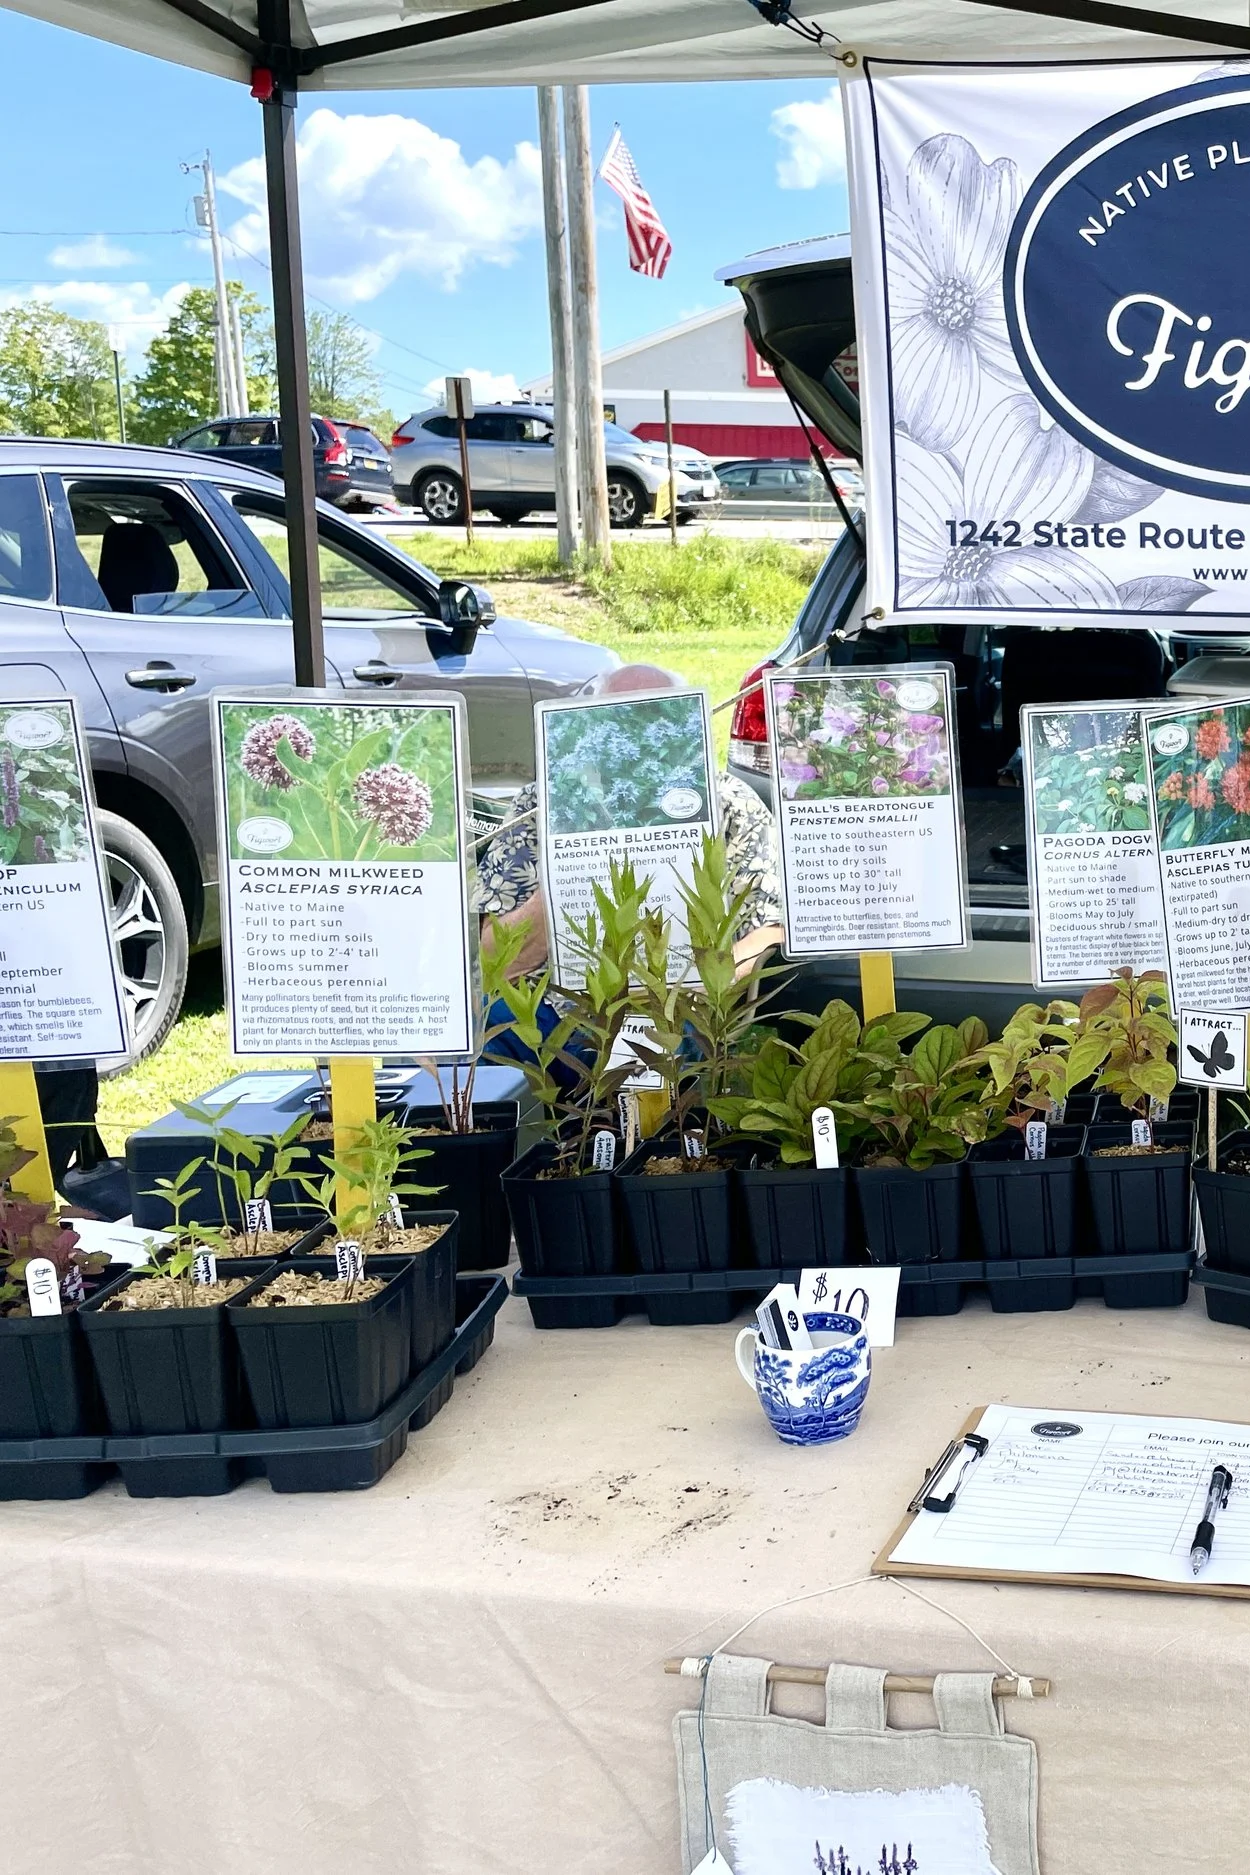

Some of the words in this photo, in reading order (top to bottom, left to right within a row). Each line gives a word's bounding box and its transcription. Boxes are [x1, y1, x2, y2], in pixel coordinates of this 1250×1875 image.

[1078, 154, 1195, 247] NATIVE
[945, 520, 1022, 547] 1242
[1033, 520, 1127, 549] State
[1140, 522, 1245, 550] Route
[788, 804, 840, 814] SMALL'S
[845, 802, 934, 812] BEARDTONGUE
[790, 816, 864, 826] PENSTEMON
[868, 814, 918, 823] SMALLII
[554, 836, 618, 849] EASTERN
[624, 828, 699, 844] BLUESTAR
[830, 832, 842, 840] to
[845, 830, 915, 840] southeastern
[918, 827, 933, 836] US
[1043, 837, 1106, 848] PAGODA
[554, 850, 600, 860] AMSONIA
[1044, 850, 1100, 860] CORNUS
[1165, 848, 1235, 865] BUTTERFLY
[828, 859, 839, 867] to
[842, 857, 859, 868] dry
[862, 856, 887, 865] soils
[239, 865, 320, 877] COMMON
[329, 868, 424, 879] MILKWEED
[1167, 862, 1230, 878] ASCLEPIAS
[1198, 878, 1208, 887] to
[1210, 873, 1250, 885] southern
[240, 883, 340, 894] ASCLEPIAS
[346, 884, 422, 895] SYRIACA
[1169, 890, 1218, 904] (extirpated)
[289, 904, 302, 912] to
[307, 902, 345, 913] Maine
[1085, 910, 1104, 920] May
[1106, 910, 1116, 918] to
[1117, 909, 1134, 920] July
[272, 933, 285, 942] to
[289, 932, 340, 942] medium
[344, 932, 373, 943] soils
[1, 966, 63, 981] eptember
[1147, 1432, 1195, 1442] Please
[1198, 1438, 1224, 1446] join
